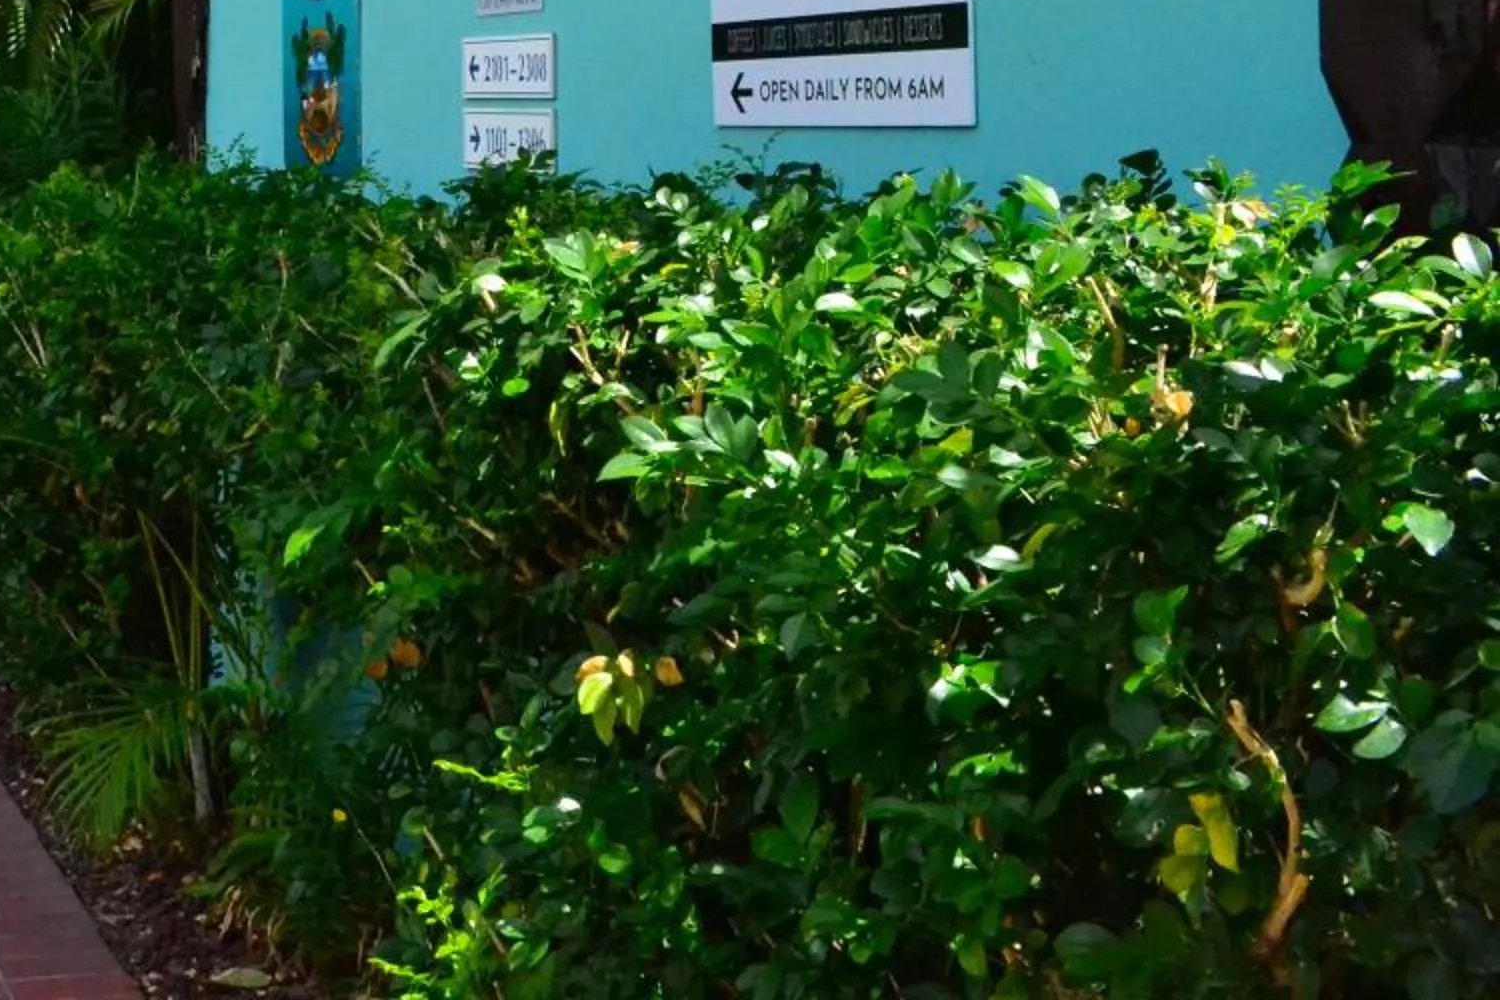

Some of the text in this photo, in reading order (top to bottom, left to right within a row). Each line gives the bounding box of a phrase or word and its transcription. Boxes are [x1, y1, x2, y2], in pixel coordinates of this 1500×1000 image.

[758, 74, 945, 103] OPEN DAILY FROM 6AM
